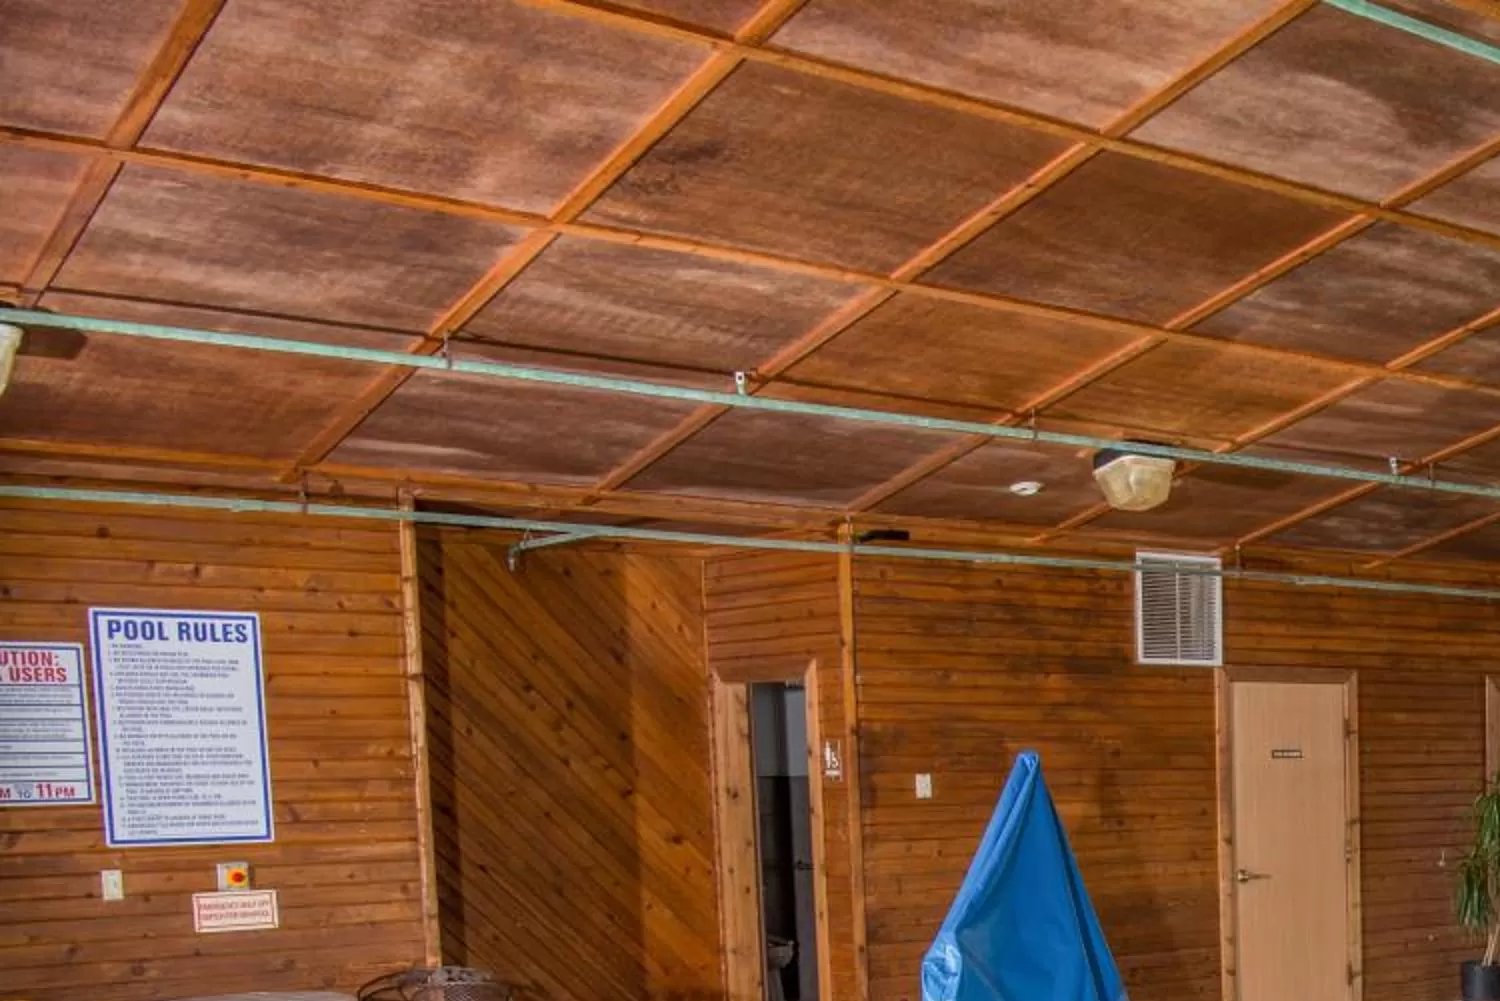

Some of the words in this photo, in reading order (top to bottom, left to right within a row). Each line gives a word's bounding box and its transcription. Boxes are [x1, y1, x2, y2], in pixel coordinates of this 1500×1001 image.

[107, 619, 169, 641] POOL
[177, 621, 249, 643] RULES
[9, 667, 67, 682] USERS
